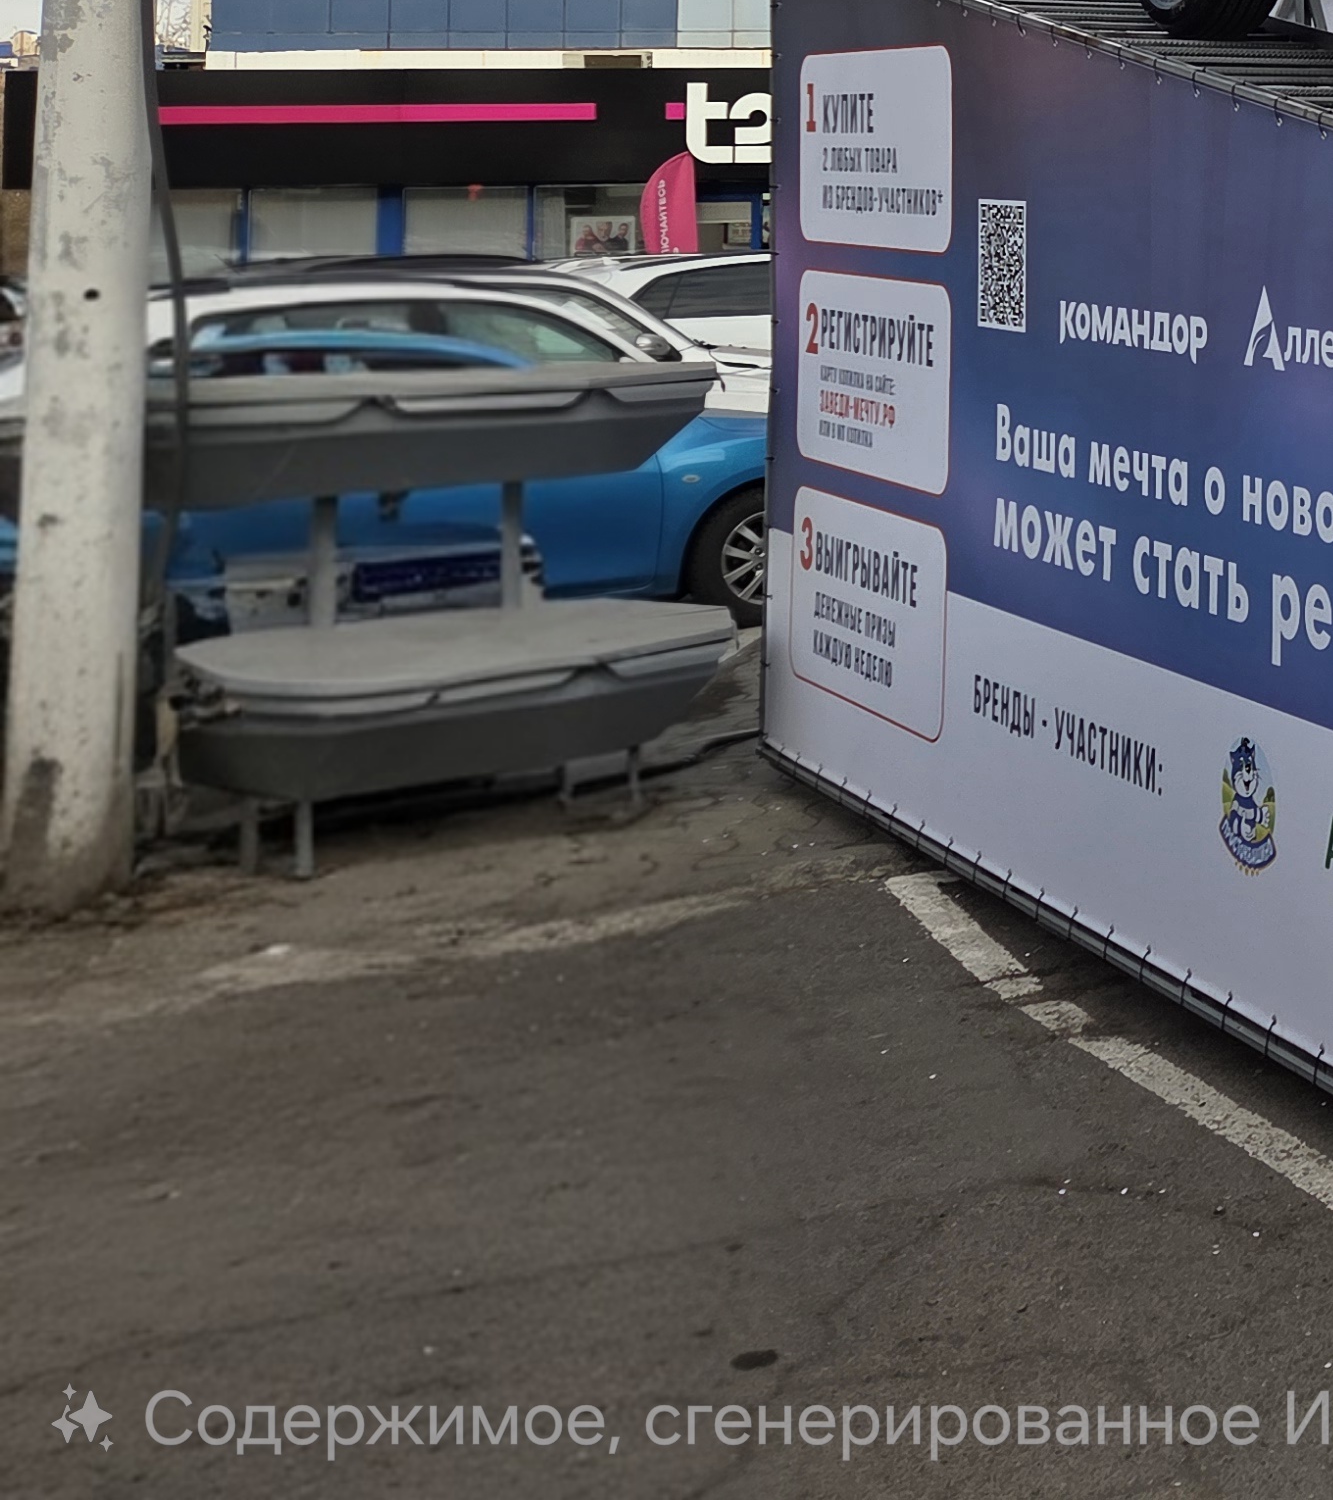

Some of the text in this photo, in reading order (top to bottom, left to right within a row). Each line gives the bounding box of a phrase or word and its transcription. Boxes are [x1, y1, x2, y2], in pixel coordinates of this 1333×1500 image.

[806, 83, 874, 133] 1 КУПИТЕ
[822, 147, 898, 173] 2 ЛЮБЫХ ТОВАРА
[805, 303, 934, 368] 2 РЕГИСТРИРУЙТЕ
[995, 403, 1076, 480] Ваша
[1088, 439, 1188, 506] мечта
[1204, 466, 1225, 515] о
[800, 517, 918, 608] 3 ВЫИГРЫВАЙТЕ
[993, 498, 1117, 583] может
[1132, 536, 1250, 624] стать
[974, 674, 1036, 739] БРЕНДЫ
[1054, 707, 1163, 797] УЧАСТНИКИ:
